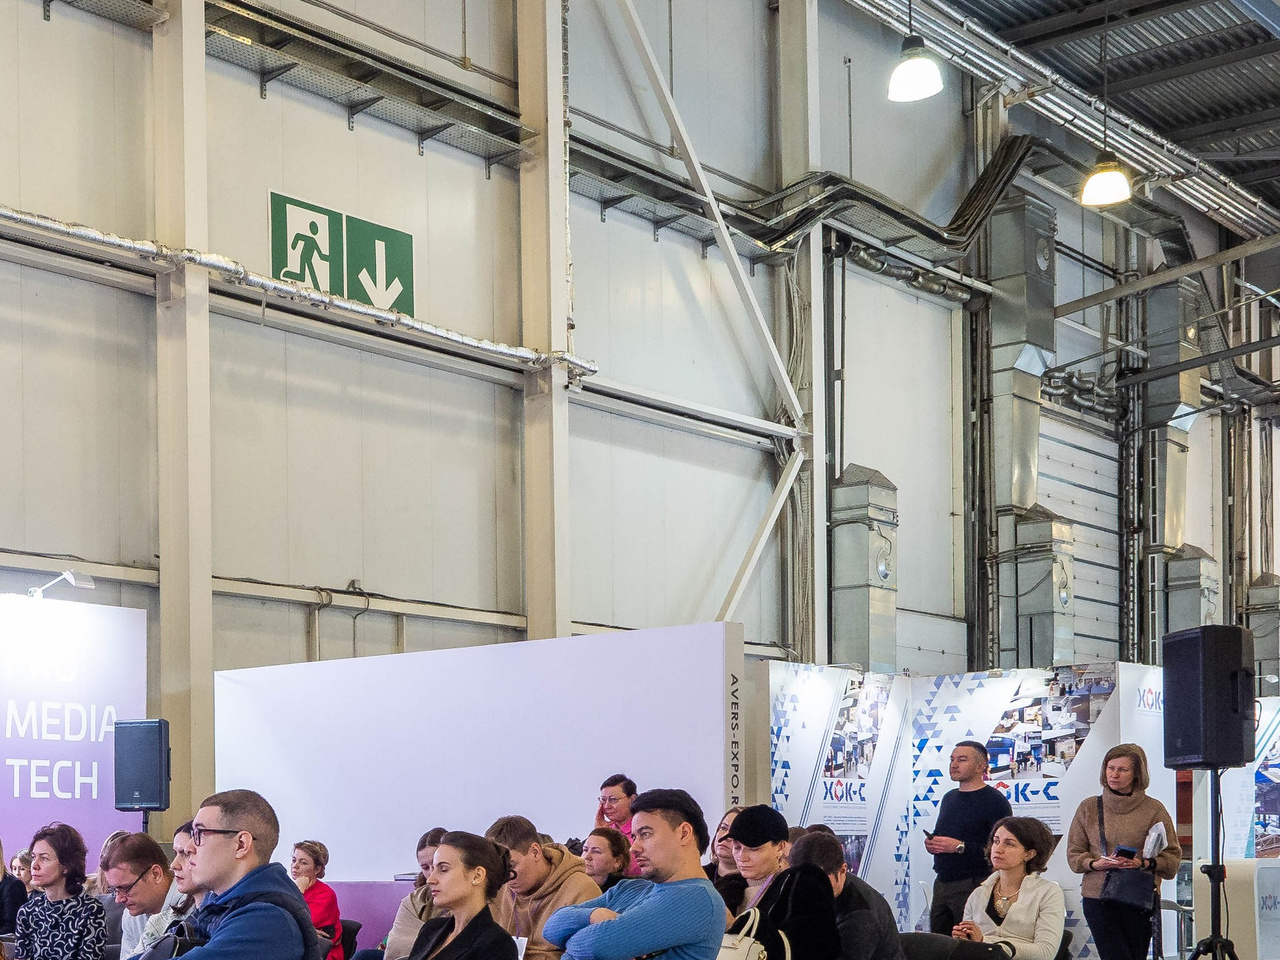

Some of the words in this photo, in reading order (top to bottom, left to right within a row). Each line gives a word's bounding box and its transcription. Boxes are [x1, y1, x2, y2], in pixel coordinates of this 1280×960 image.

[5, 700, 118, 743] MEDIA
[730, 673, 740, 805] AVERS-EXPO.R
[5, 758, 99, 800] TECH
